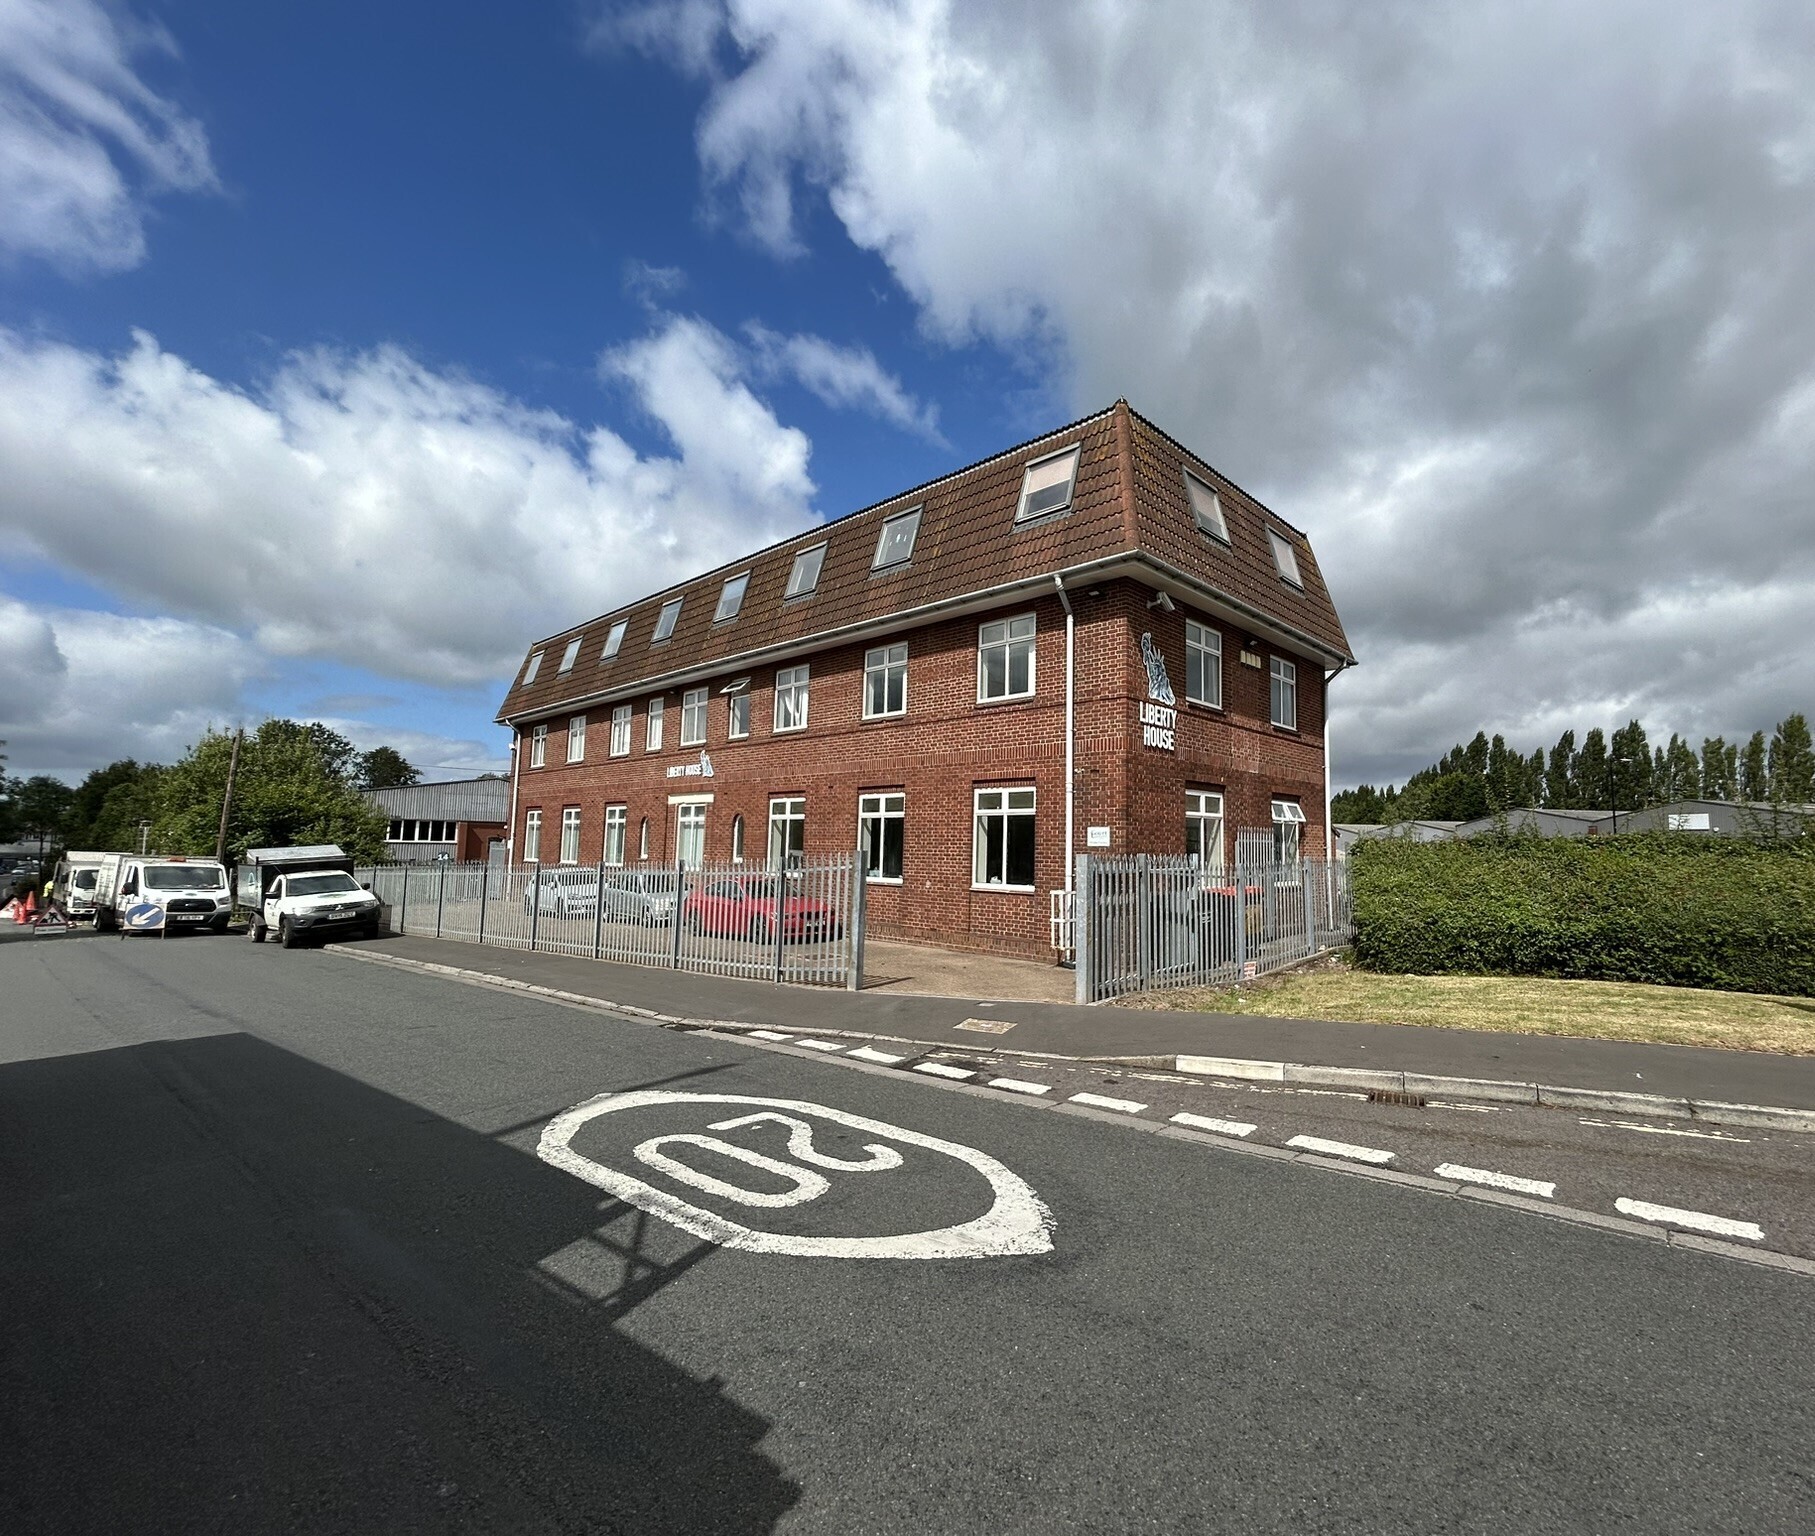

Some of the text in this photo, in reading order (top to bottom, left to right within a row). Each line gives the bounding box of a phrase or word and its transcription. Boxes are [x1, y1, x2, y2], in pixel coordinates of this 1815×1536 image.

[1139, 701, 1177, 729] LIBERTY
[1143, 725, 1175, 751] HOUSE
[632, 1111, 904, 1208] 20
